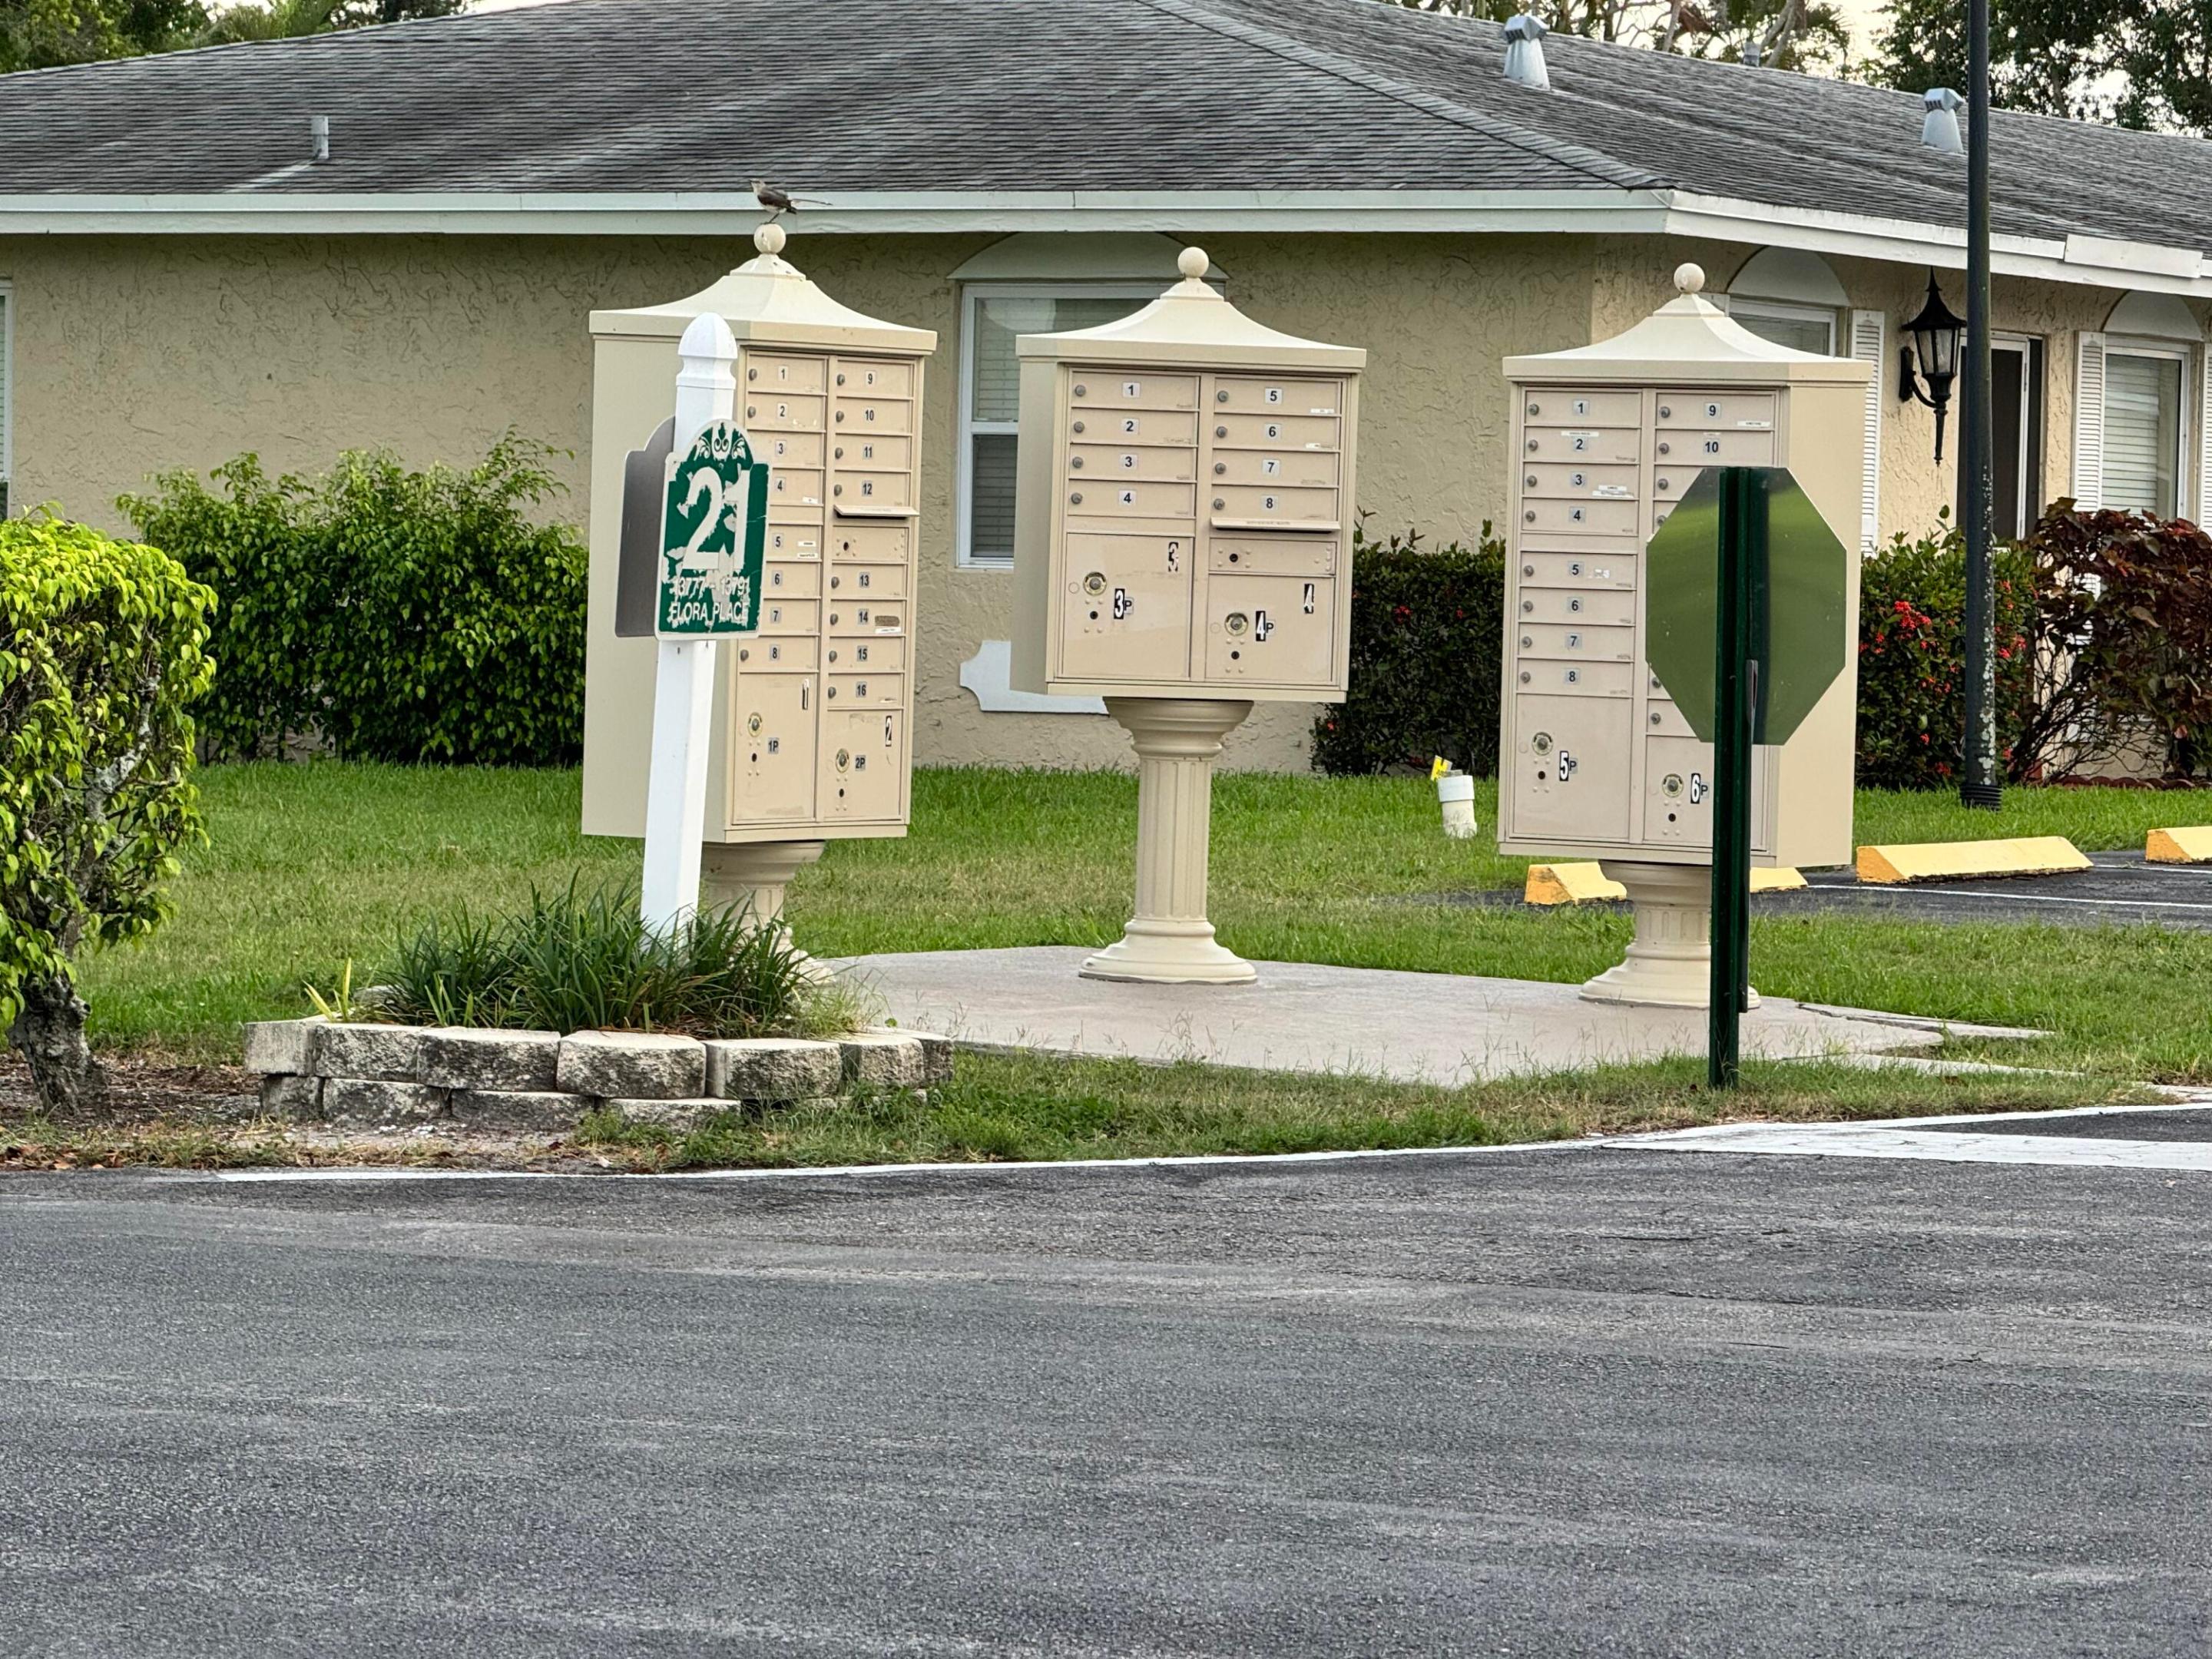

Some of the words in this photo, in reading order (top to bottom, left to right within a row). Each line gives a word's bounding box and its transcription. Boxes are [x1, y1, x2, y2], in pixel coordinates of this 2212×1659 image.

[864, 409, 876, 422] 10
[863, 445, 873, 459] 11
[1704, 440, 1720, 454] 10
[862, 482, 873, 496] 12
[681, 466, 750, 570] 21
[859, 574, 870, 588] 13
[671, 602, 707, 621] FLORA
[713, 602, 750, 622] PLACE
[858, 610, 869, 624] 14
[856, 647, 869, 661] 15
[856, 683, 867, 697] 16
[767, 738, 781, 755] 1P
[853, 755, 868, 771] 2P
